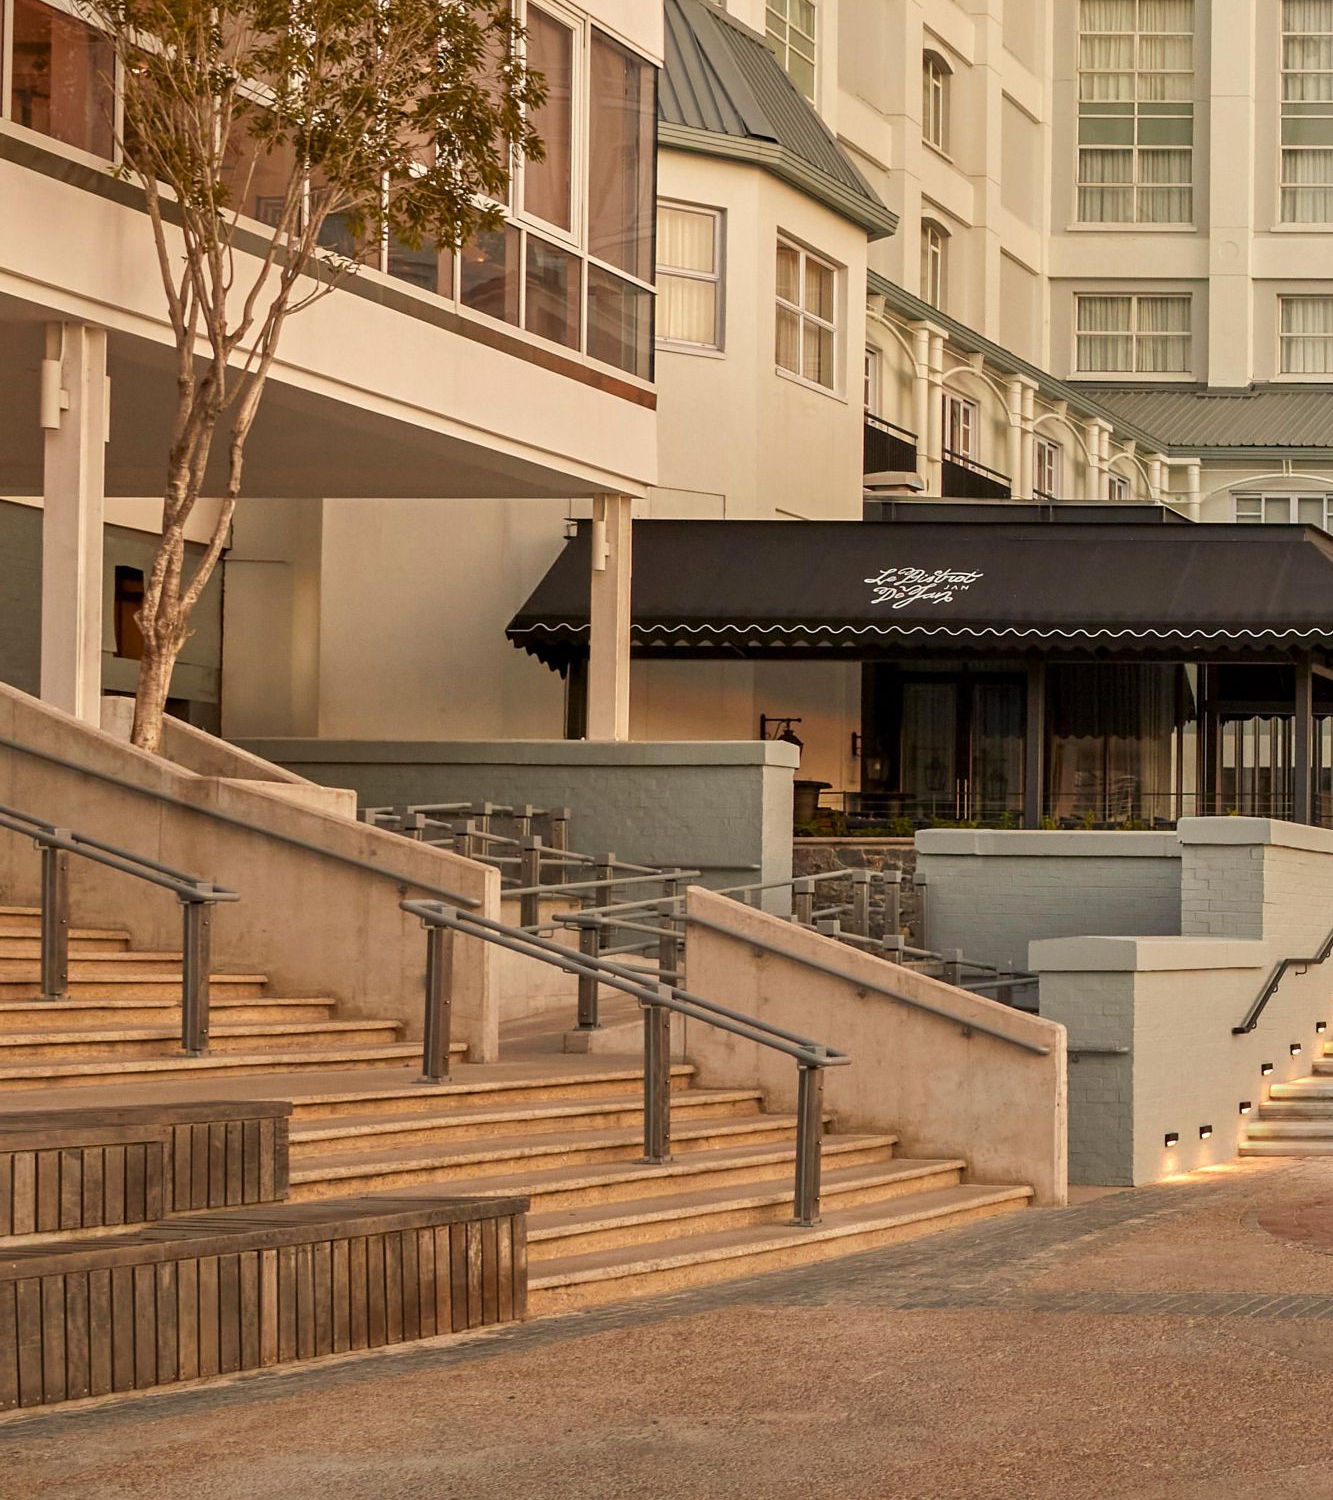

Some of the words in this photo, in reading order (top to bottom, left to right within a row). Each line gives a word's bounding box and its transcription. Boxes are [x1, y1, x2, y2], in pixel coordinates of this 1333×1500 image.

[864, 568, 898, 586] Le
[894, 567, 984, 586] Bistrot
[871, 587, 905, 604] De
[892, 583, 954, 609] Jan
